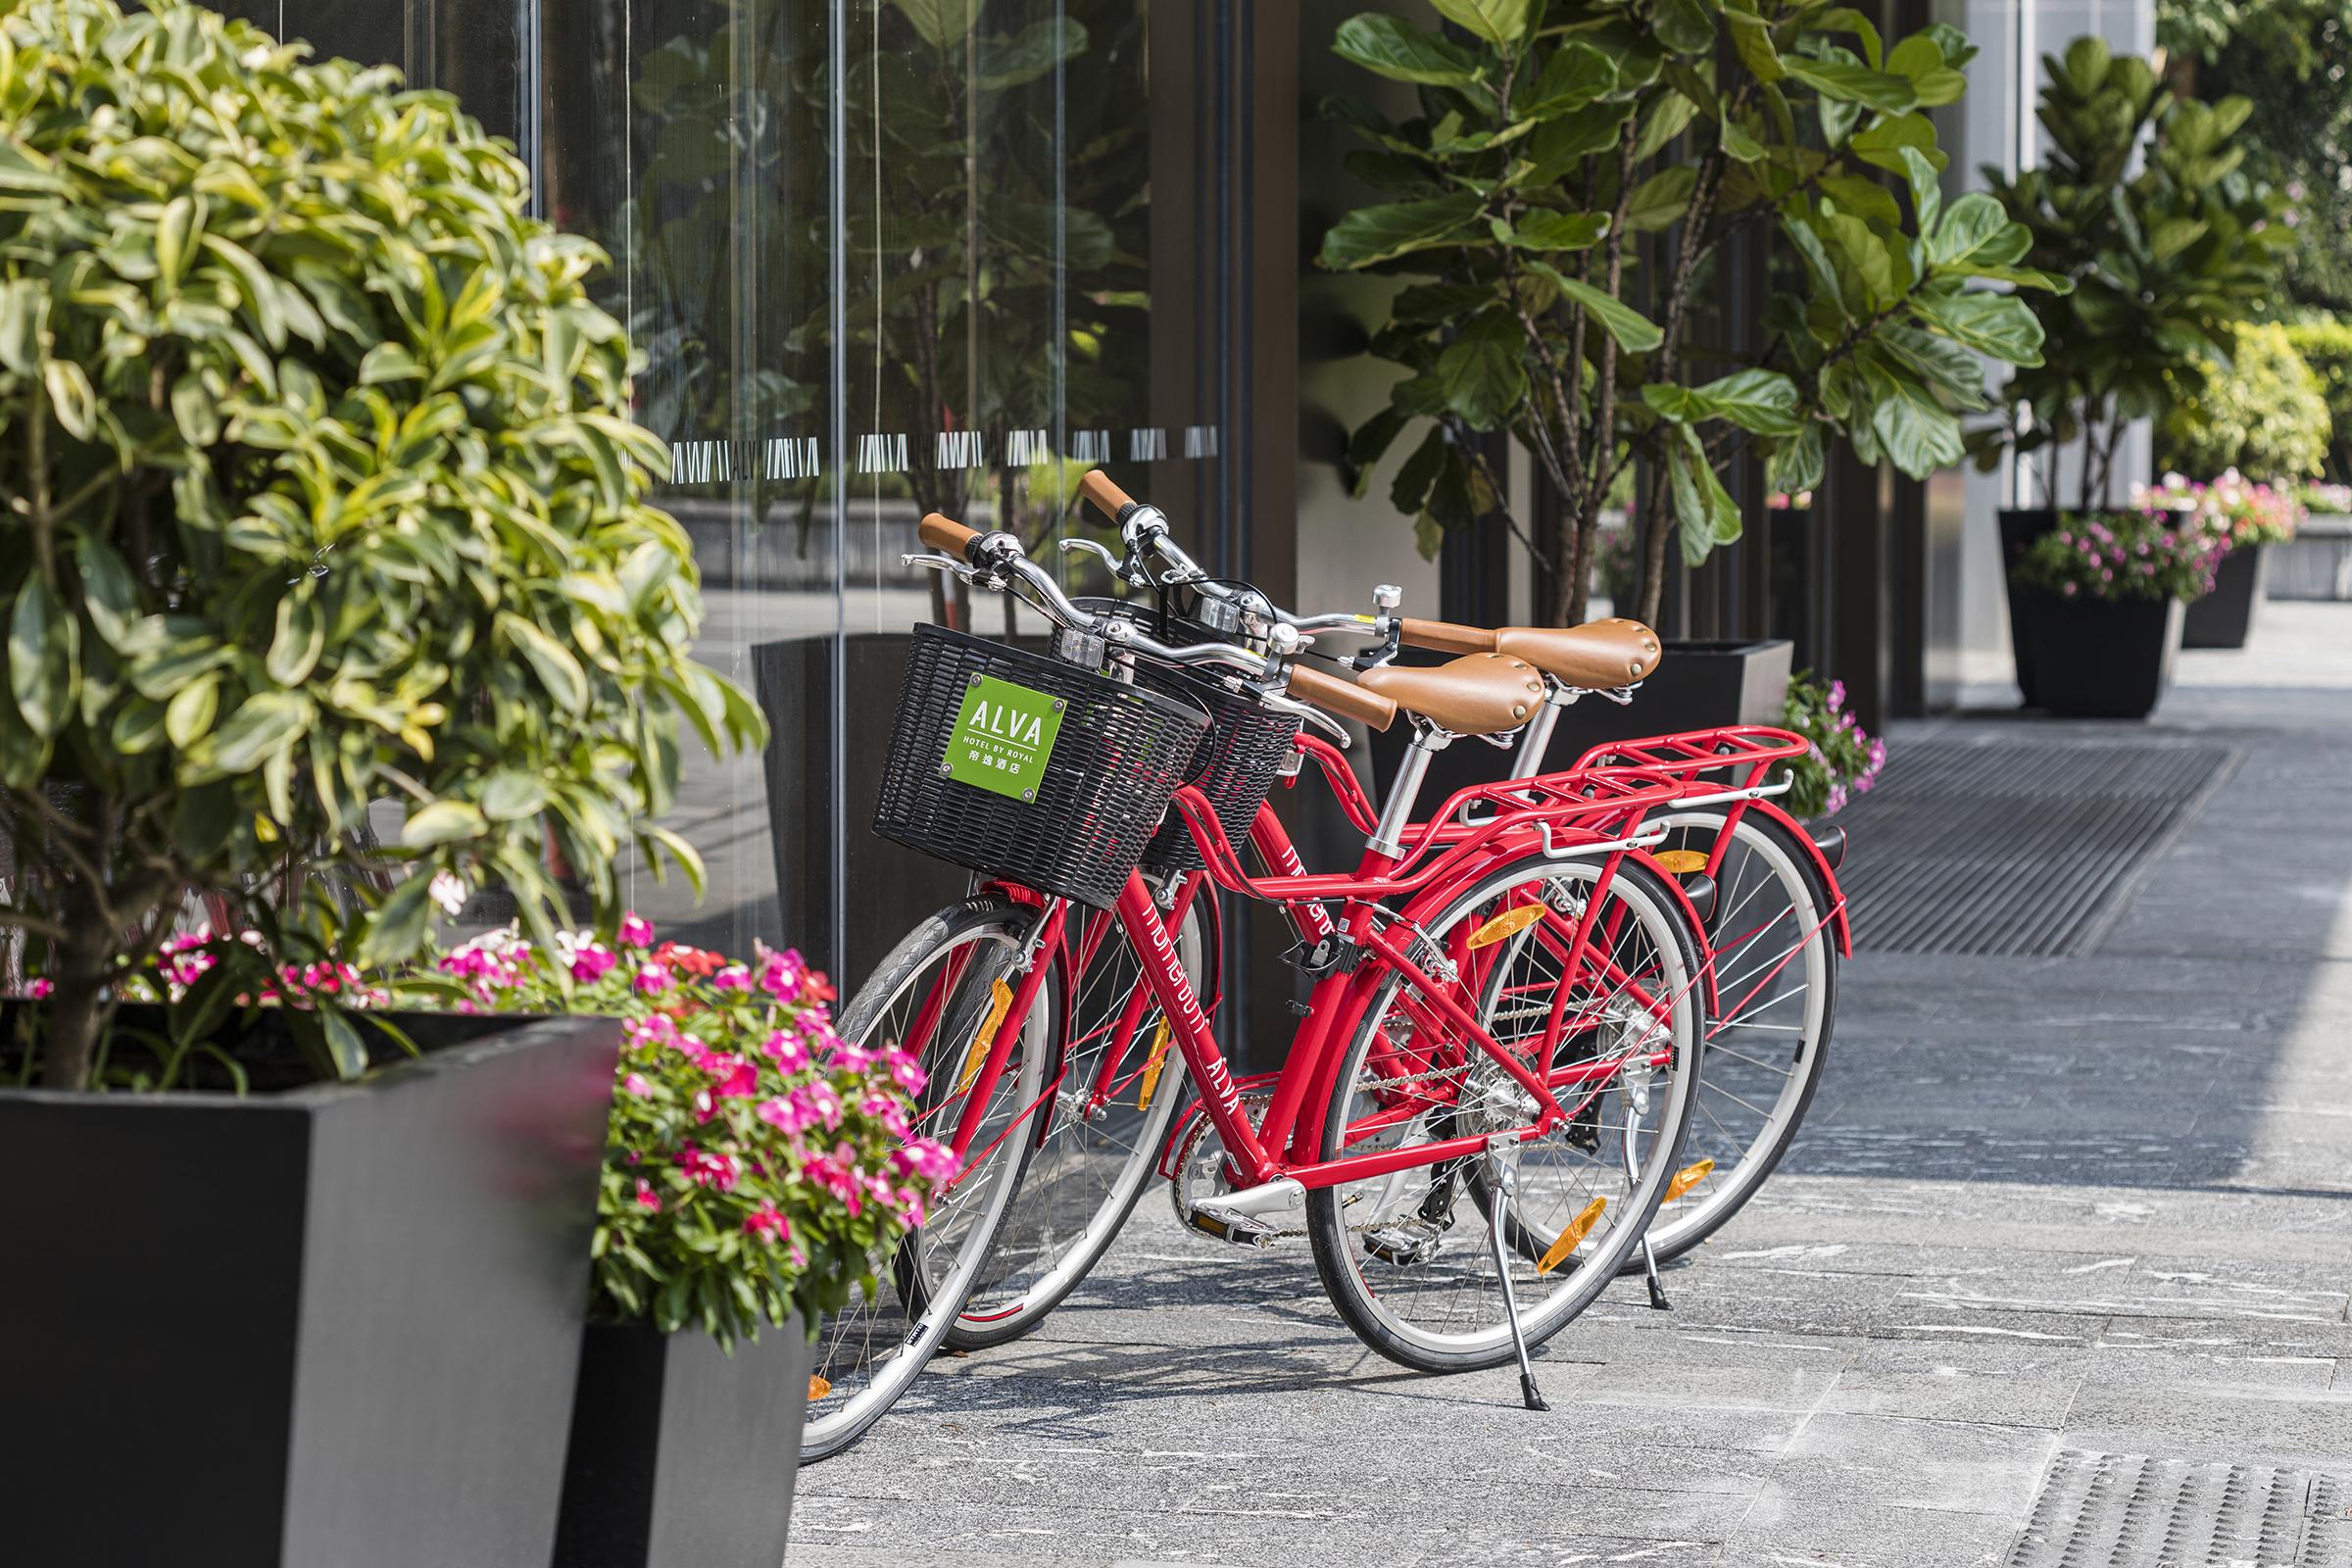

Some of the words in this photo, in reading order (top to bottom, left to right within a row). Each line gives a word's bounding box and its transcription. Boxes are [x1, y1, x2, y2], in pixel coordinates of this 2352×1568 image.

[970, 701, 1041, 745] ALVA
[963, 736, 989, 750] HOTEL
[993, 745, 1004, 755] BY
[1007, 750, 1033, 762] ROYAL
[1142, 902, 1206, 1035] momentum
[1206, 1056, 1240, 1115] ALVA
